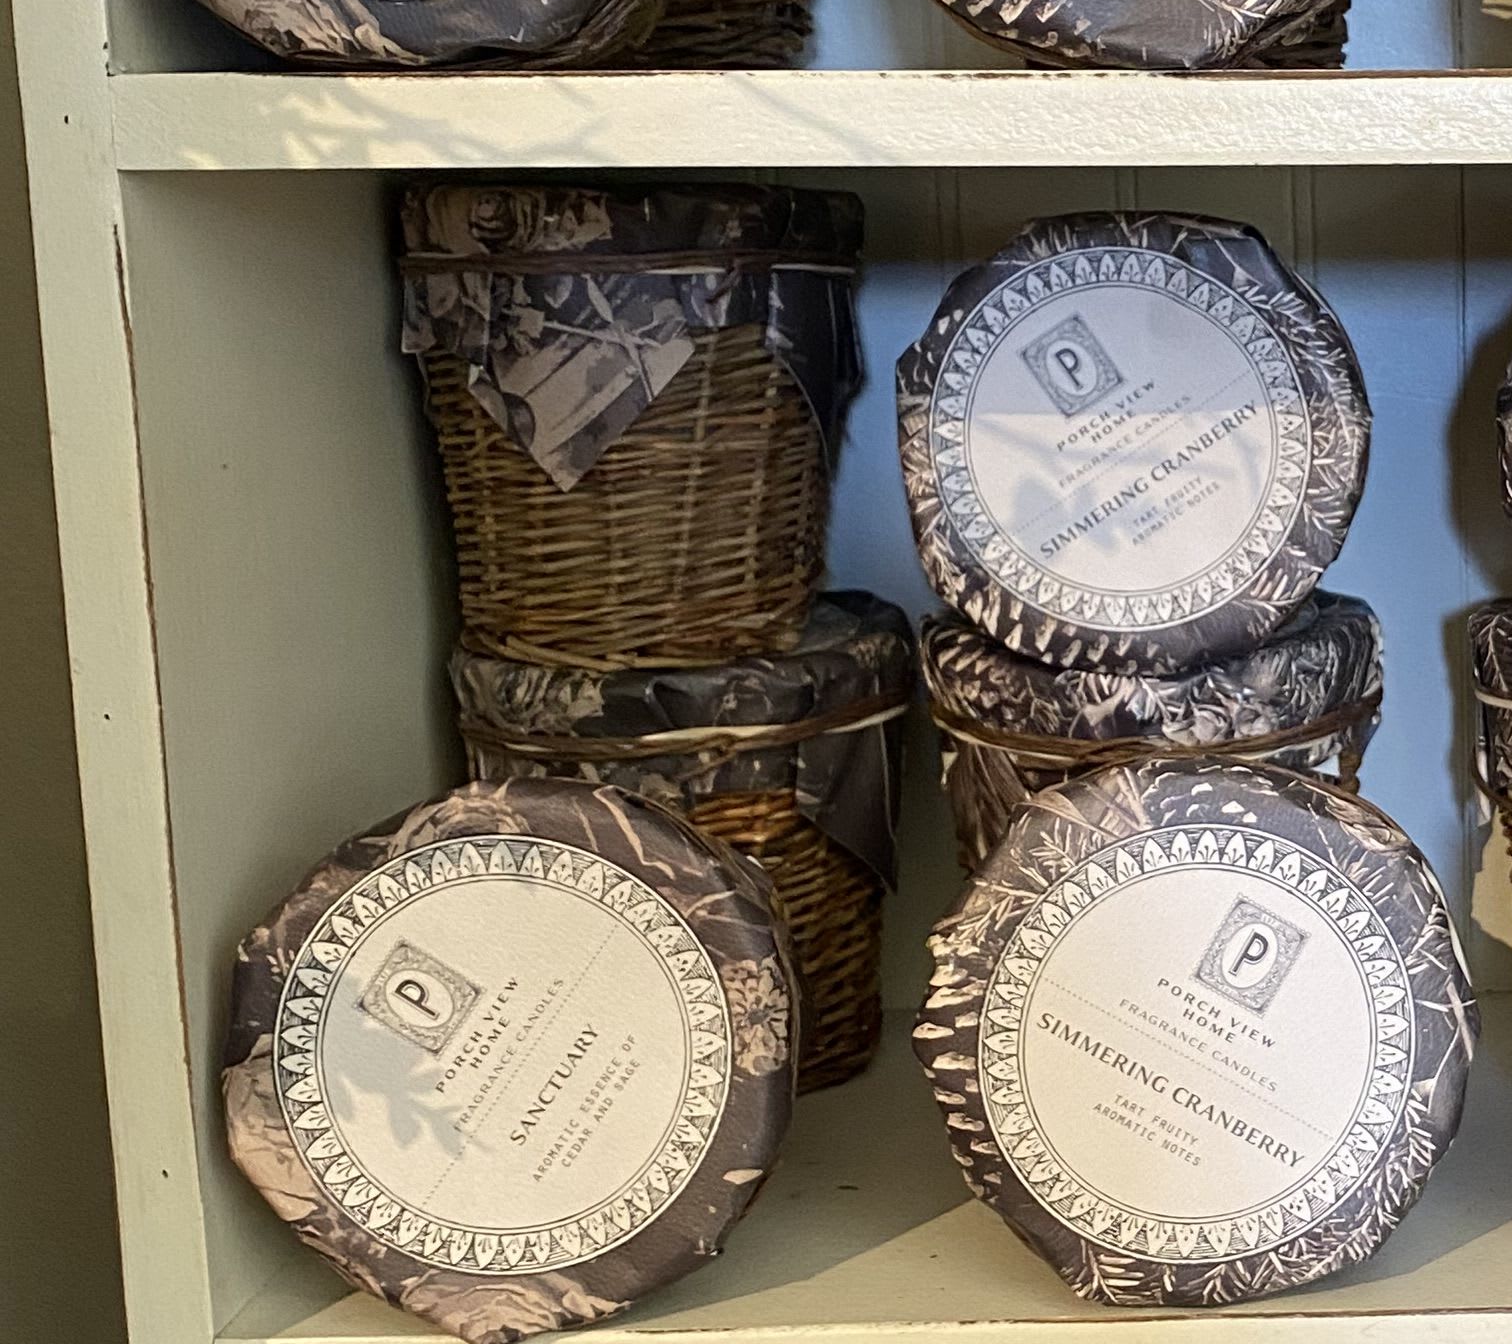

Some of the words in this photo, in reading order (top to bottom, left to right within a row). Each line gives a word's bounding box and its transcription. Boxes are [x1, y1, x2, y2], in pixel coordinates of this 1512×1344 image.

[1055, 348, 1083, 391] P
[1056, 409, 1113, 453] PORCH
[1115, 380, 1156, 412] VIEW
[1090, 408, 1137, 444] HOME
[1039, 476, 1150, 560] SIMMERING
[1150, 399, 1259, 483] CRANBERRY
[1229, 929, 1270, 977] P
[394, 979, 440, 1021] P
[434, 1030, 484, 1094] PORCH
[482, 976, 520, 1023] VIEW
[1157, 977, 1222, 1019] PORCH
[1229, 1017, 1277, 1049] VIEW
[1182, 1007, 1237, 1044] HOME
[469, 1016, 511, 1070] HOME
[509, 1023, 600, 1147] SANCTUARY
[531, 1118, 580, 1183] AROMATIC
[578, 1056, 623, 1114] ESSENCE
[620, 1033, 637, 1053] OF
[560, 1127, 594, 1169] CEDAR
[592, 1097, 614, 1124] AND
[613, 1058, 641, 1092] SAGE
[1036, 1011, 1170, 1095] SIMMERING
[1171, 1086, 1306, 1169] CRANBERRY
